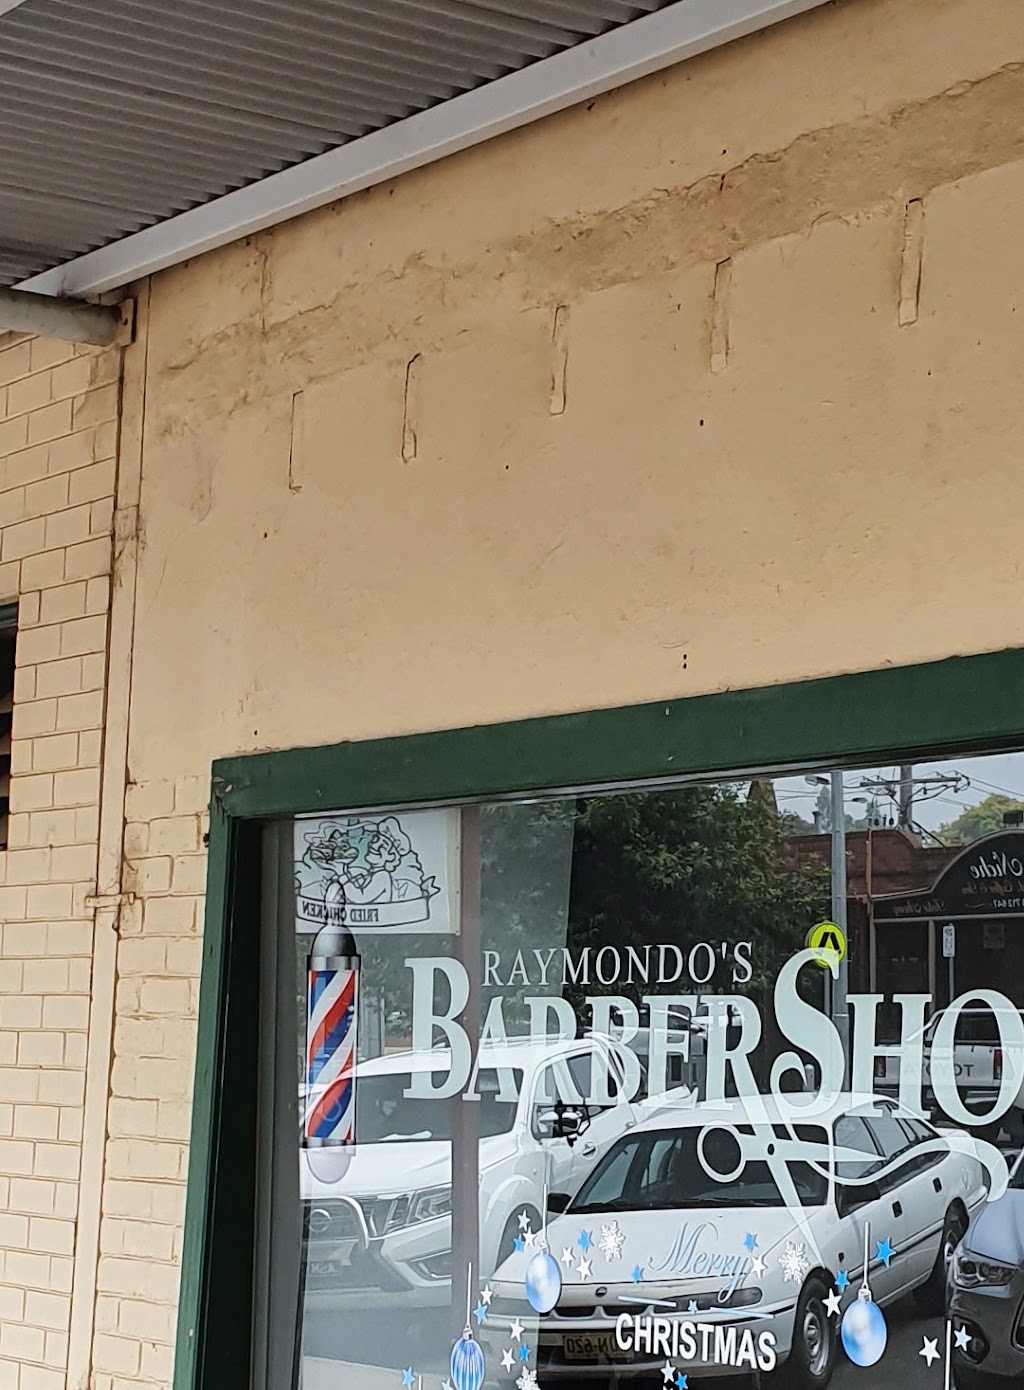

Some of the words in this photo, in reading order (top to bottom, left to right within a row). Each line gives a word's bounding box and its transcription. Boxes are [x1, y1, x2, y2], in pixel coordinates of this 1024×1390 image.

[482, 941, 754, 987] RAYMONDO'S
[647, 1221, 751, 1303] Merry
[615, 1312, 777, 1372] CHRISTMAS
